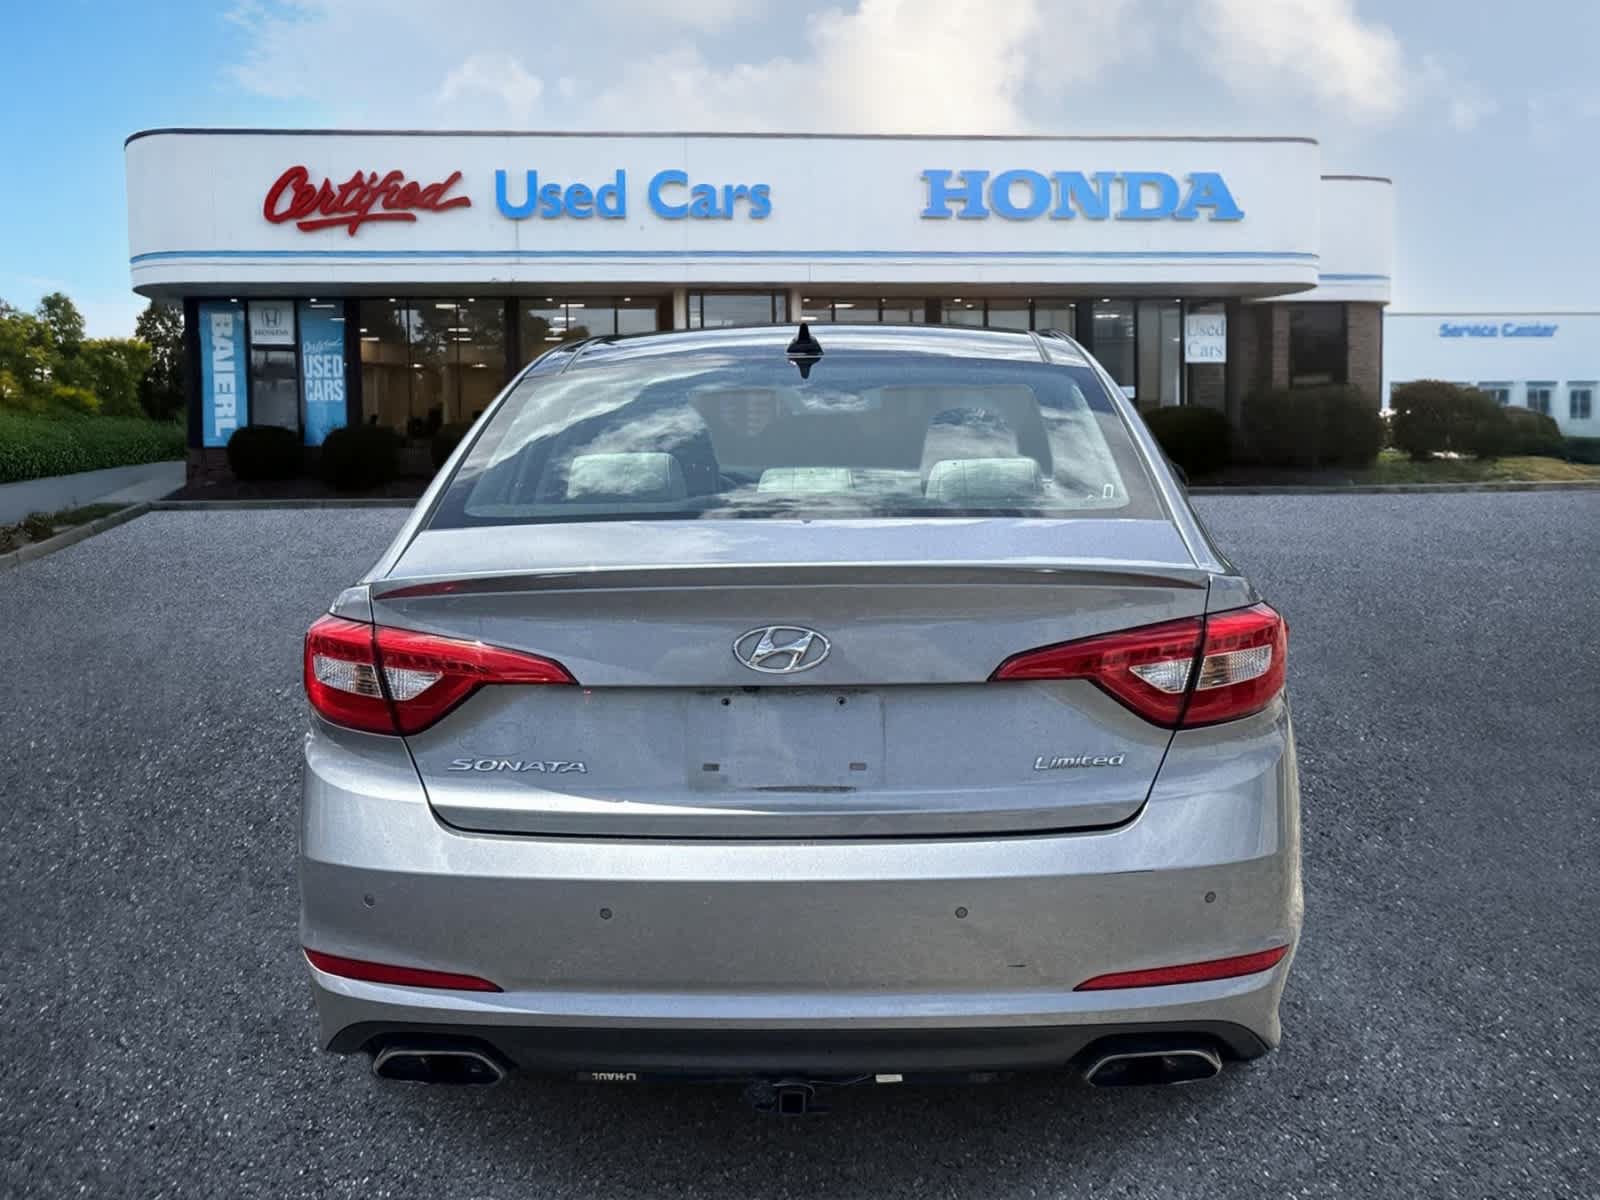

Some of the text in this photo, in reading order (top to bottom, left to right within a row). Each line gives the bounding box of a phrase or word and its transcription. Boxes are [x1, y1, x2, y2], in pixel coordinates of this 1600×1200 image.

[264, 165, 772, 236] Certified Used Cars
[920, 169, 1246, 222] HONDA
[1187, 319, 1226, 337] Used
[1439, 321, 1559, 338] Service Center
[1187, 339, 1224, 358] Cars
[211, 313, 236, 437] BAIERL
[304, 355, 342, 378] USED
[305, 379, 344, 401] CARS
[448, 757, 588, 774] SONATA
[1033, 753, 1126, 771] Limited
